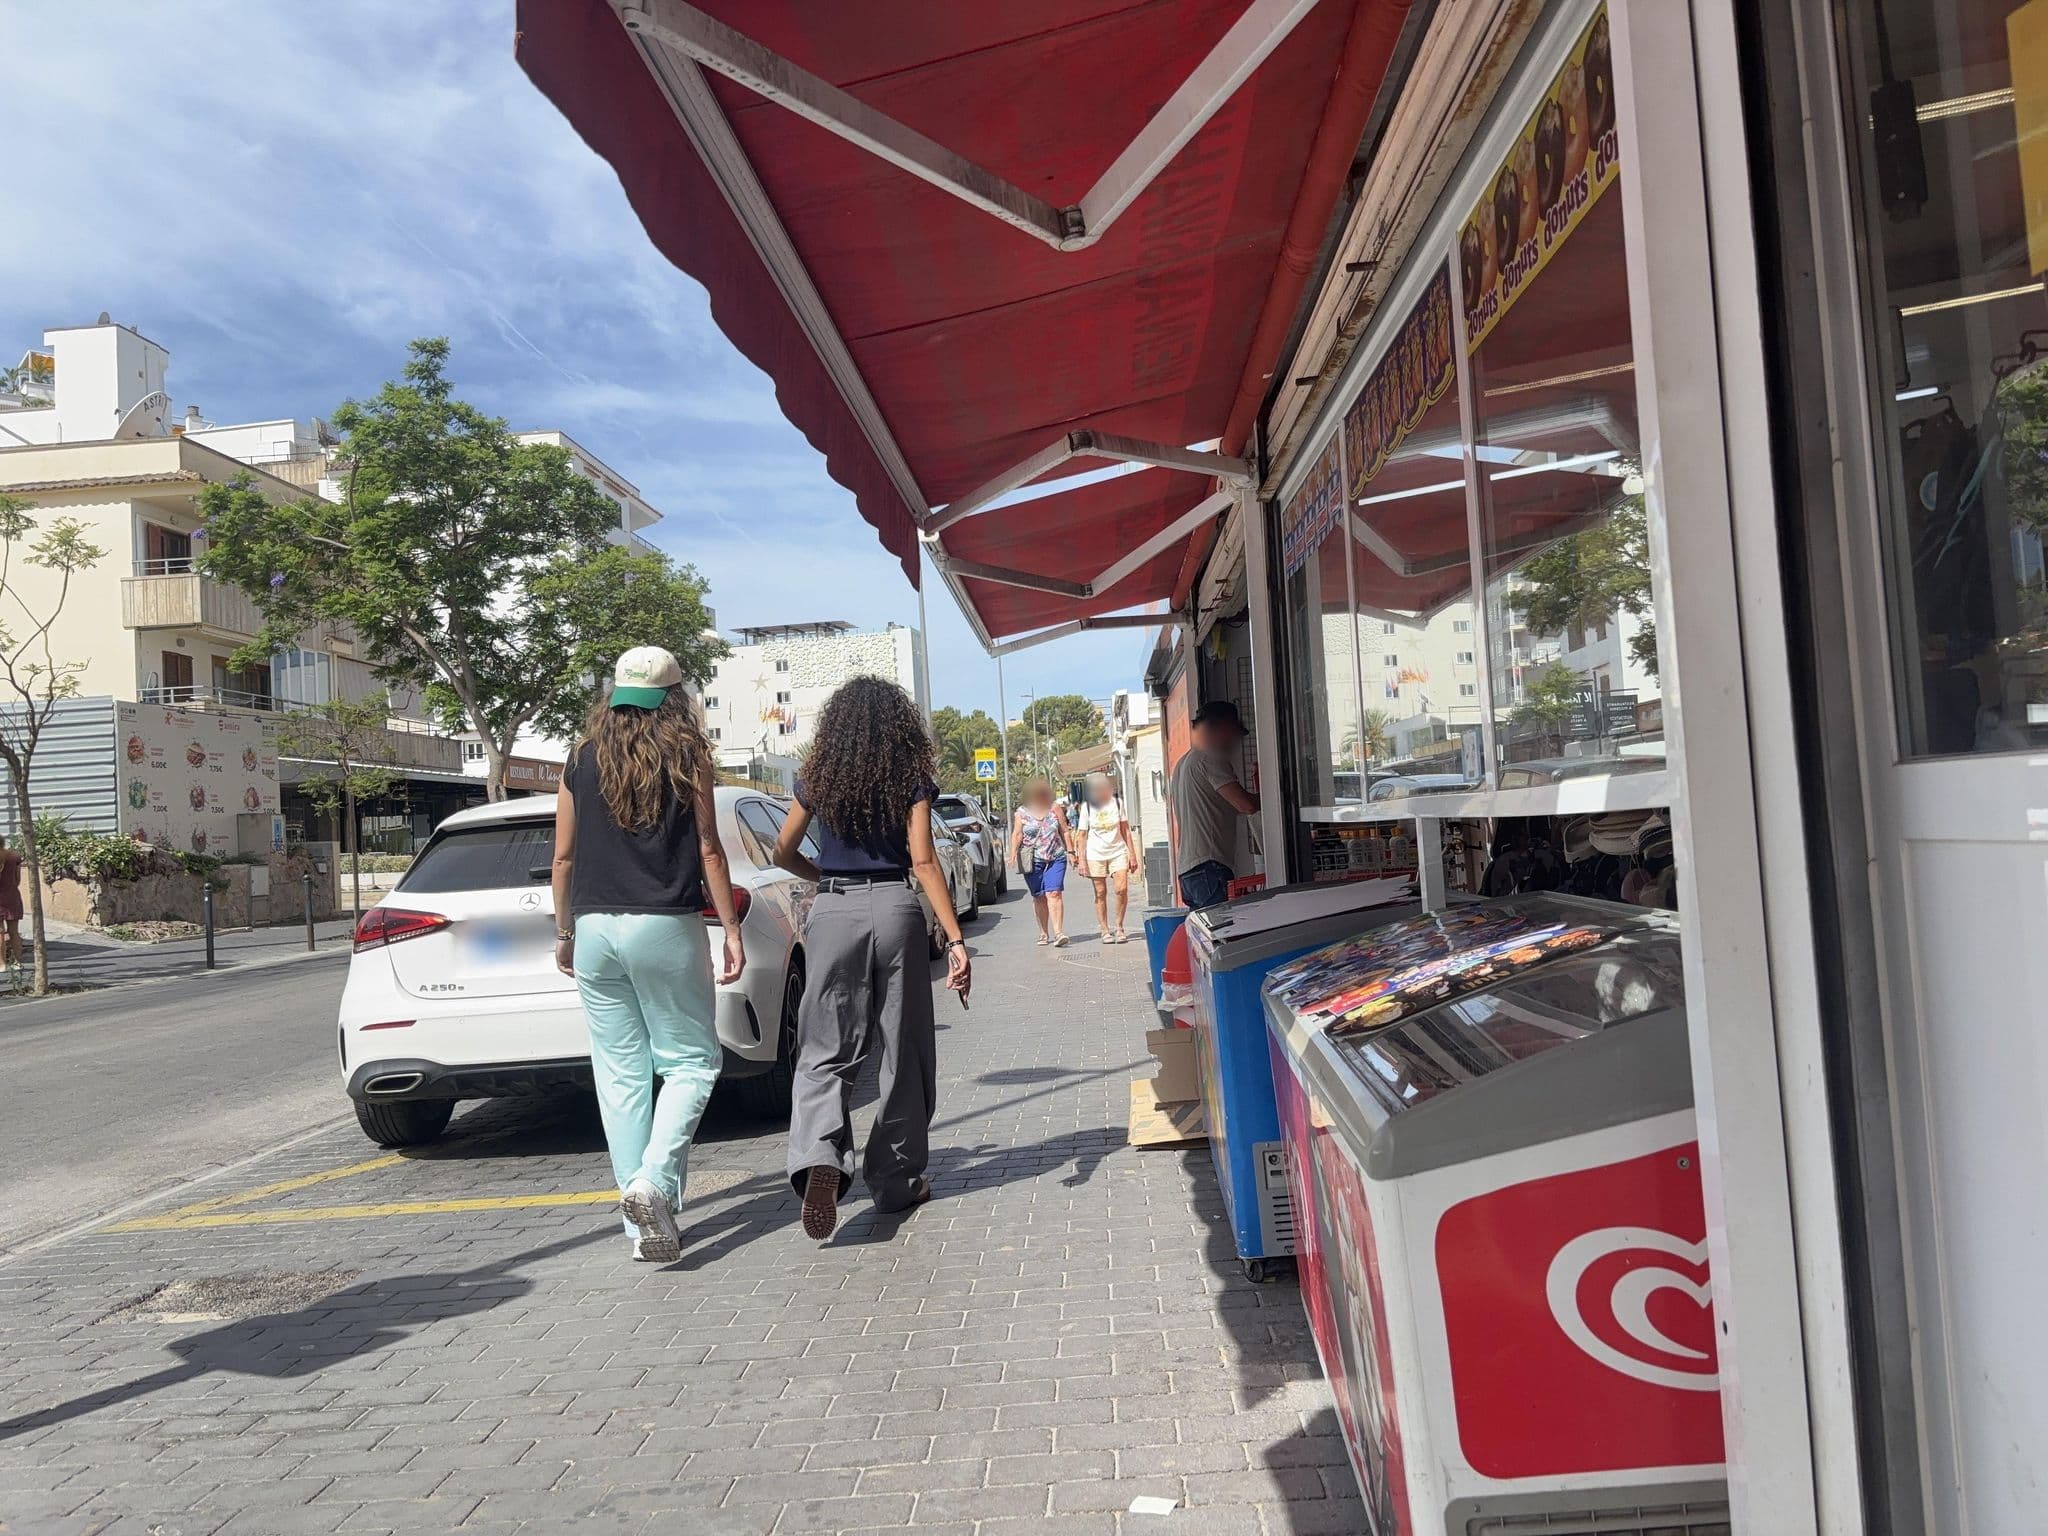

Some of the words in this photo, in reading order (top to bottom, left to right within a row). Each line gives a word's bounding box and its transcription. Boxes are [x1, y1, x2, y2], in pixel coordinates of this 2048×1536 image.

[1467, 287, 1499, 344] donuts
[1502, 236, 1539, 301] donuts
[1544, 169, 1589, 249] donuts
[419, 984, 428, 992] A
